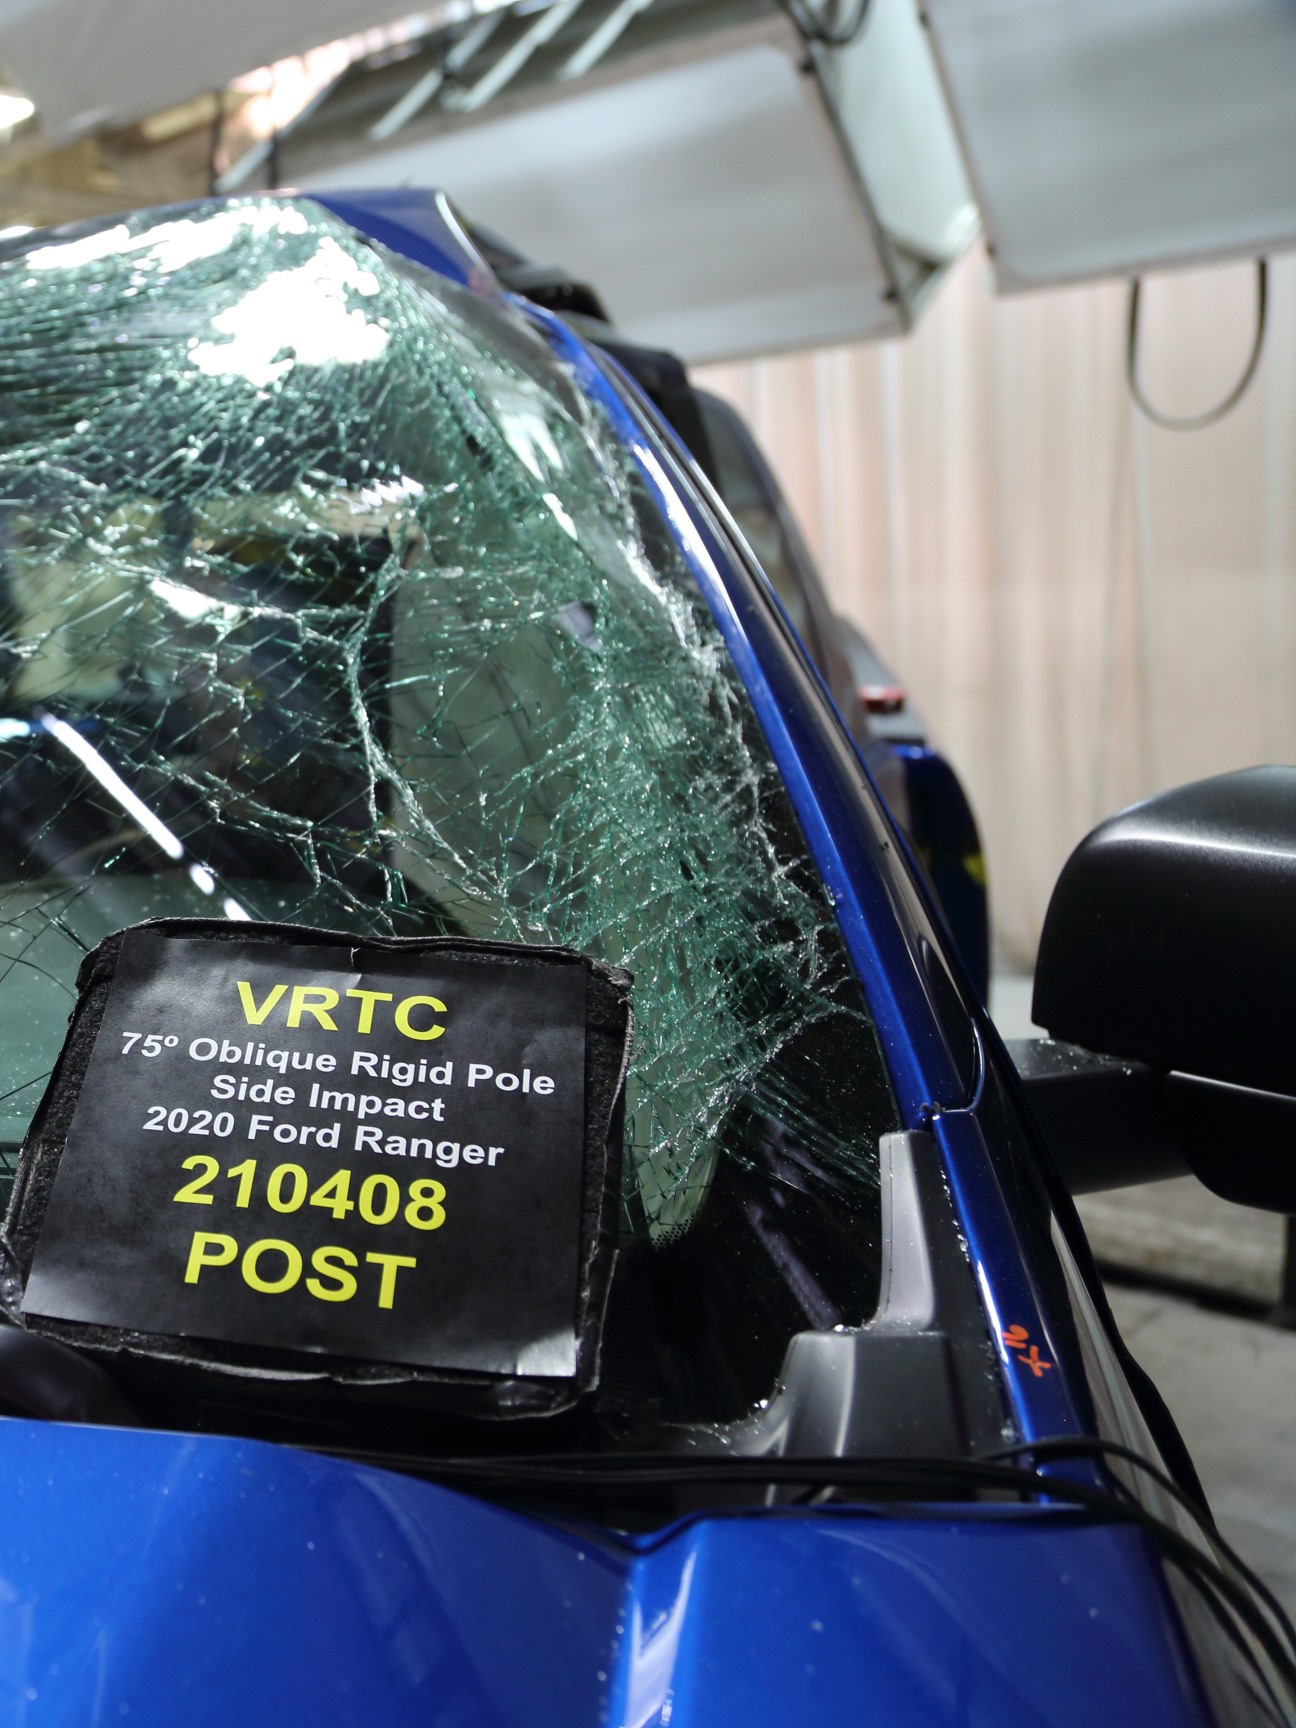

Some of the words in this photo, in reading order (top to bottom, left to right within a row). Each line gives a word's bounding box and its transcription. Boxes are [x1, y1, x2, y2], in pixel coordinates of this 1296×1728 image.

[236, 981, 448, 1041] VRTC
[188, 1036, 337, 1074] Oblique
[350, 1051, 454, 1087] Rigid
[466, 1063, 556, 1096] Pole
[209, 1074, 296, 1105] Side
[308, 1082, 446, 1122] Impact
[141, 1105, 236, 1138] 2020
[247, 1114, 342, 1150] Ford
[354, 1126, 506, 1168] Ranger
[172, 1154, 448, 1231] 210408
[183, 1231, 418, 1309] POST
